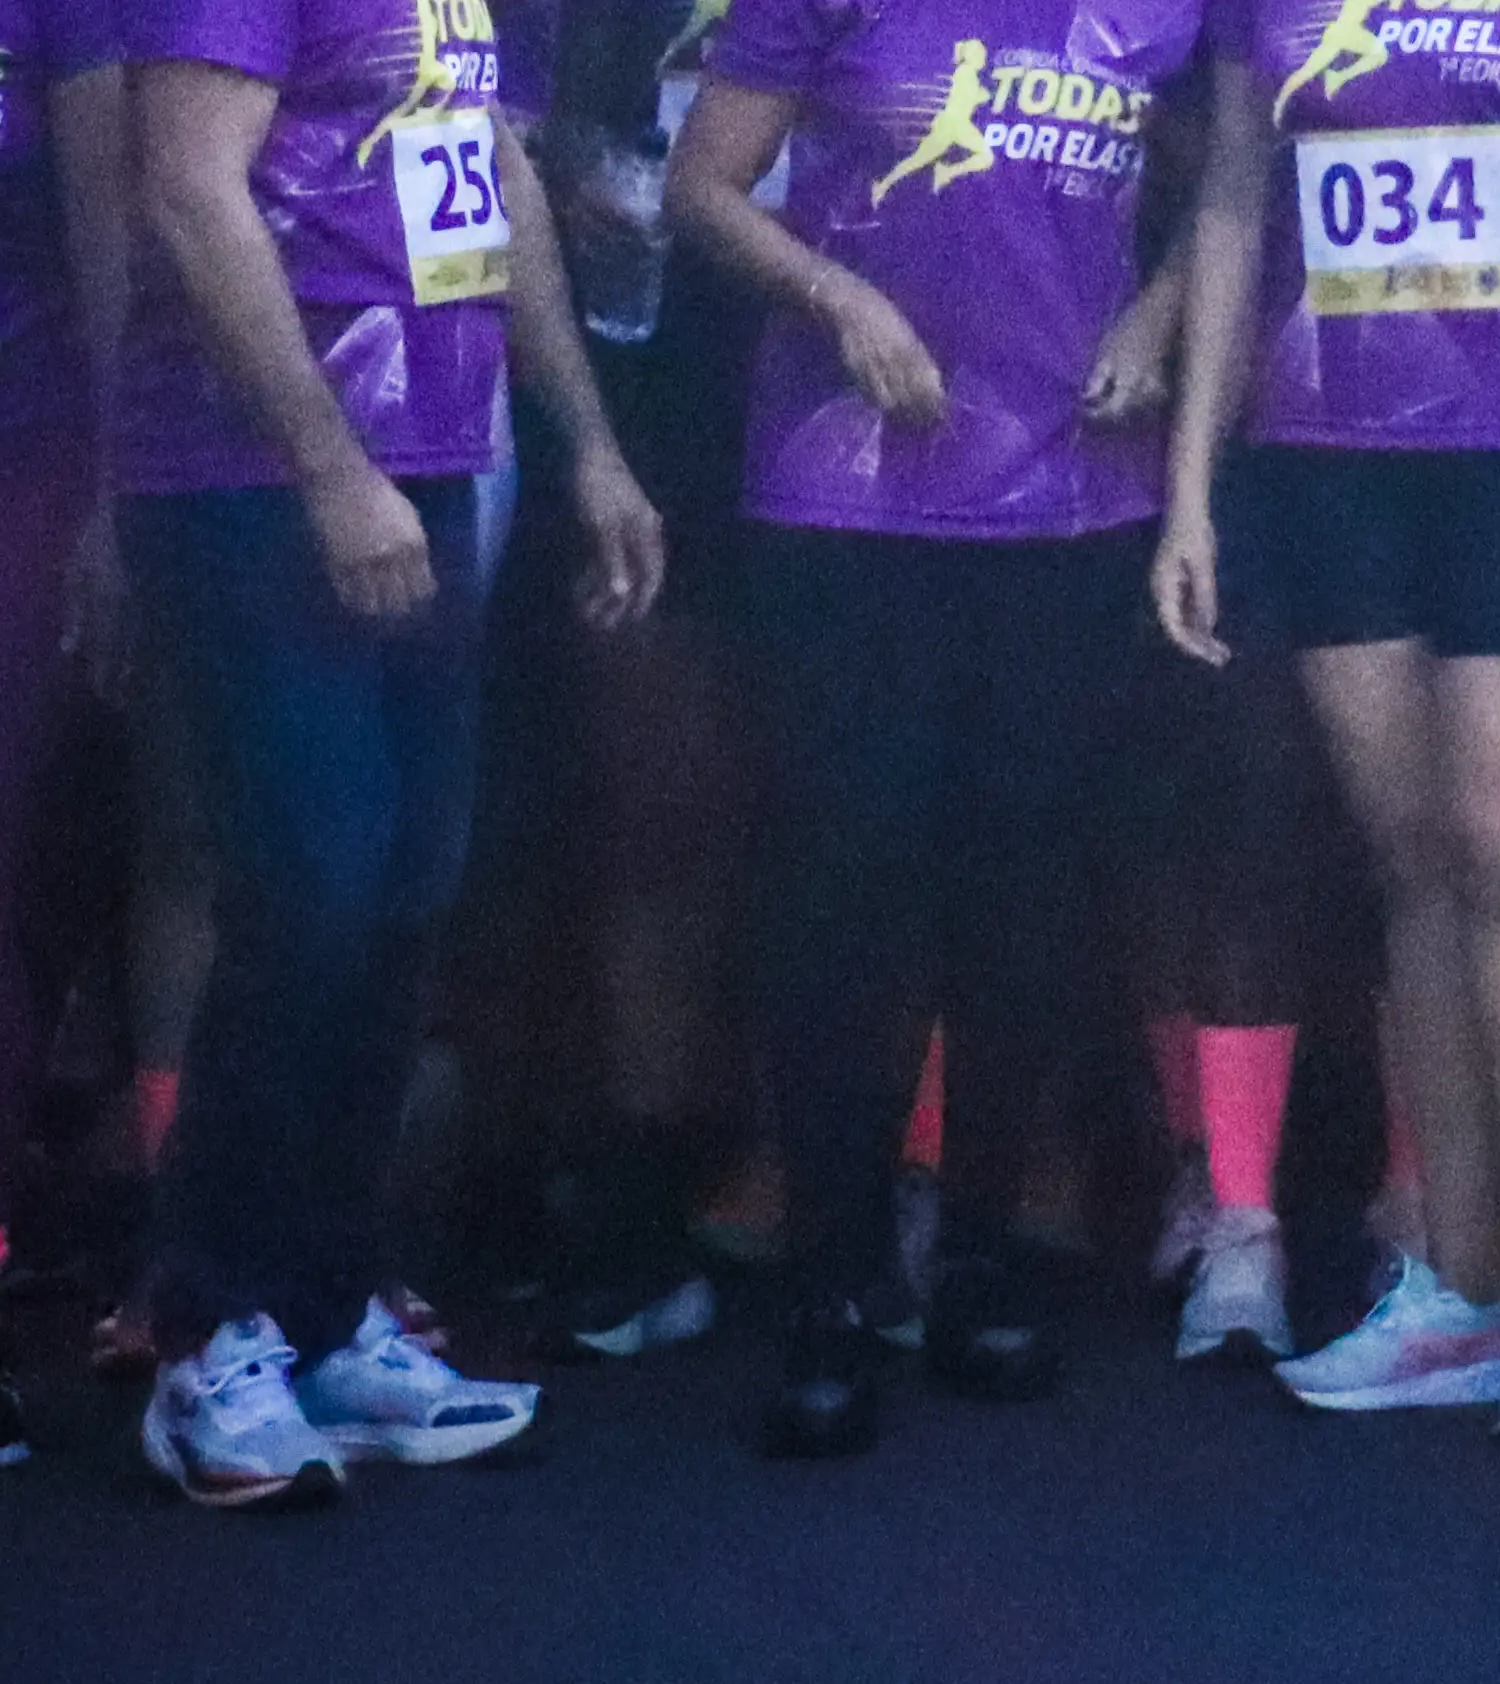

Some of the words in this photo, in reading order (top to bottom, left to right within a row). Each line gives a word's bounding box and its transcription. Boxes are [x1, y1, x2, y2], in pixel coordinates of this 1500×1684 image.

[1379, 18, 1453, 54] POR
[991, 65, 1153, 134] TODAS
[983, 122, 1059, 163] POR
[421, 140, 509, 231] 25
[1319, 157, 1485, 246] 034
